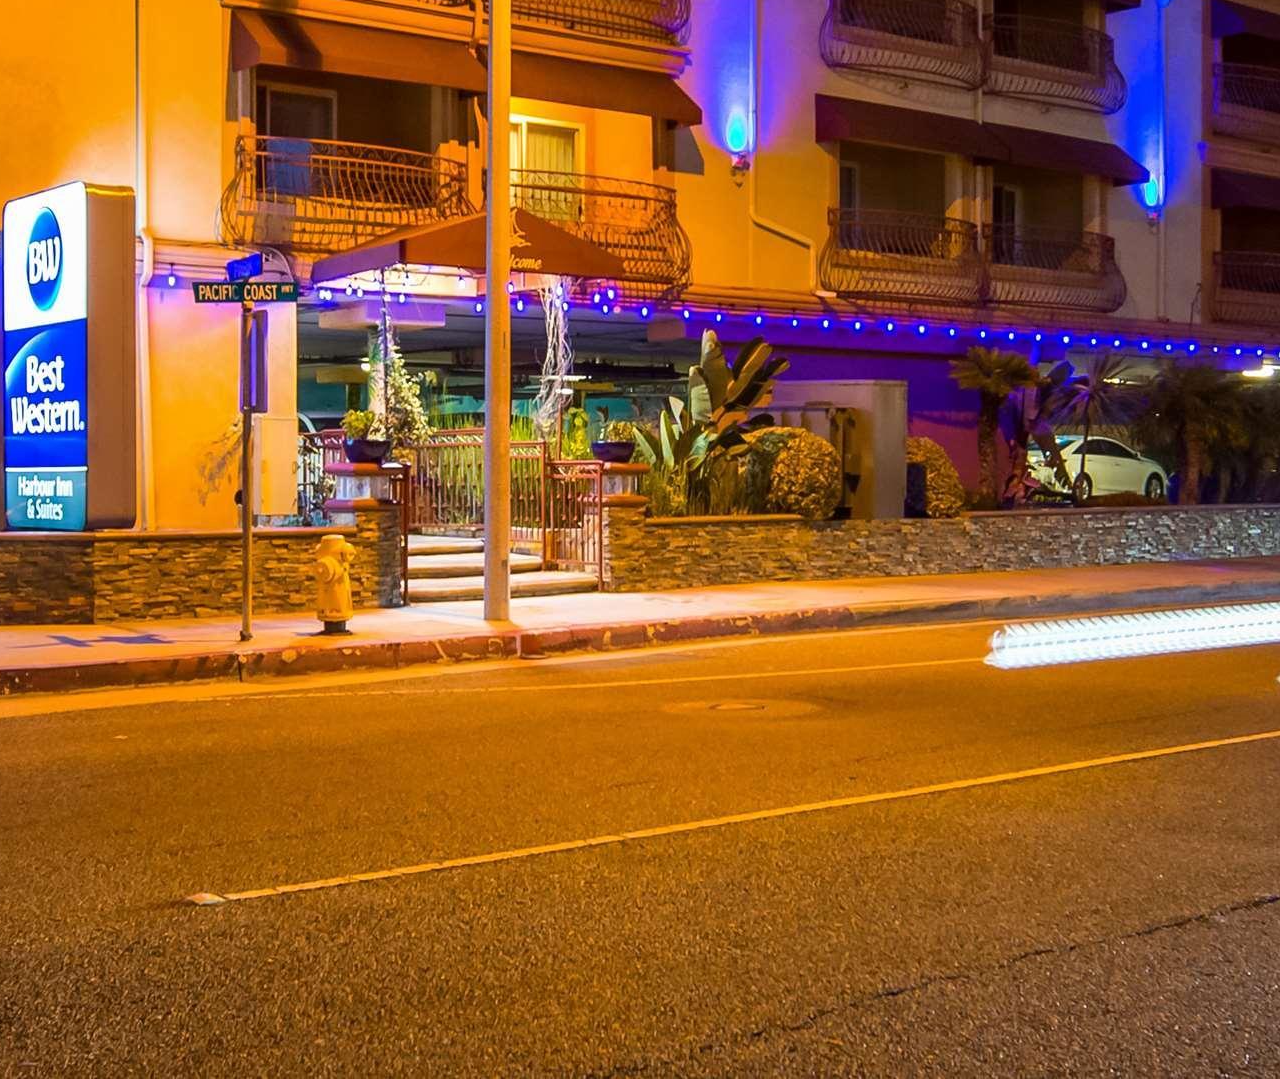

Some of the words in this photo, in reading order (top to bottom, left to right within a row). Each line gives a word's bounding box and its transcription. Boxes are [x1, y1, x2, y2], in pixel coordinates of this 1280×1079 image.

[27, 235, 61, 285] BW
[510, 254, 542, 271] lcome
[198, 284, 240, 300] PACIFIC
[243, 284, 278, 300] COAST
[25, 355, 65, 394] Best
[17, 474, 55, 497] Harbour
[56, 475, 74, 497] Inn
[26, 498, 35, 520] &
[35, 498, 64, 521] Suites
